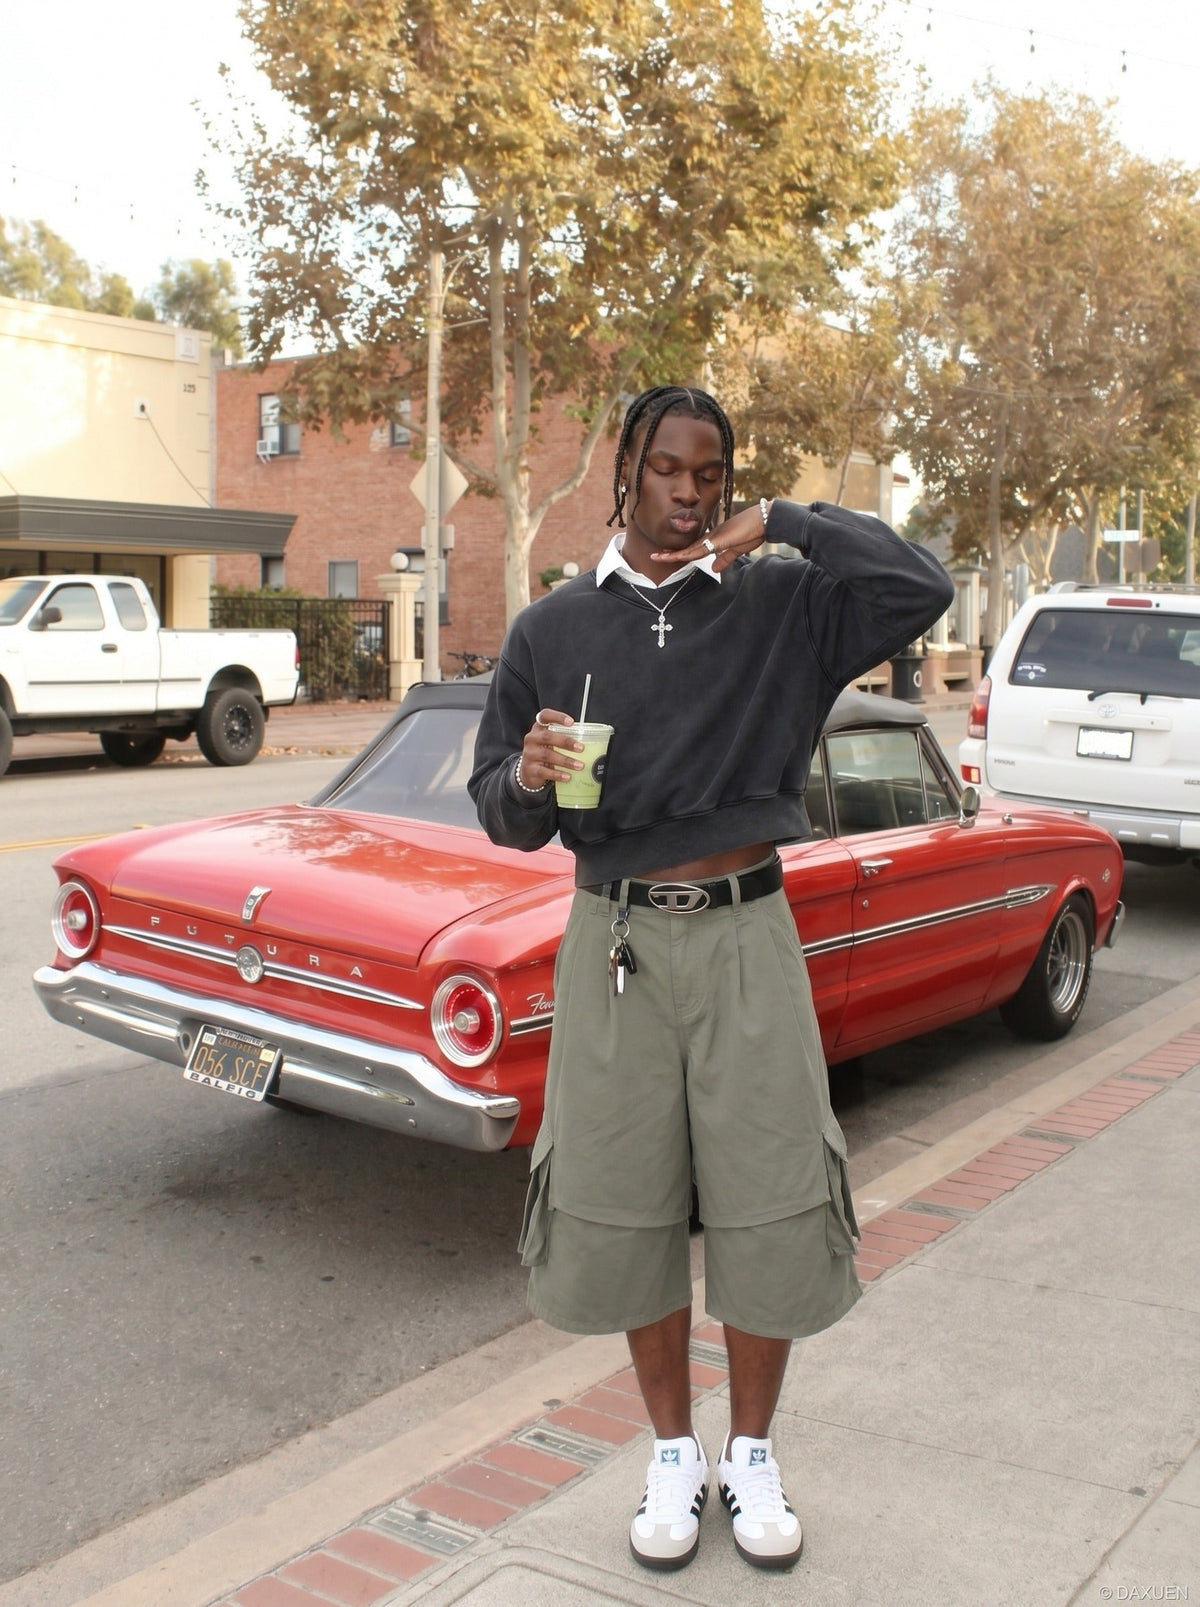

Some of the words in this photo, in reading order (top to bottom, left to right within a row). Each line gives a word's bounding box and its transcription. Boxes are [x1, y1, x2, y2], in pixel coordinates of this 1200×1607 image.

[150, 916, 363, 978] FUTURA
[193, 1046, 228, 1077] 056
[229, 1056, 268, 1088] SCF
